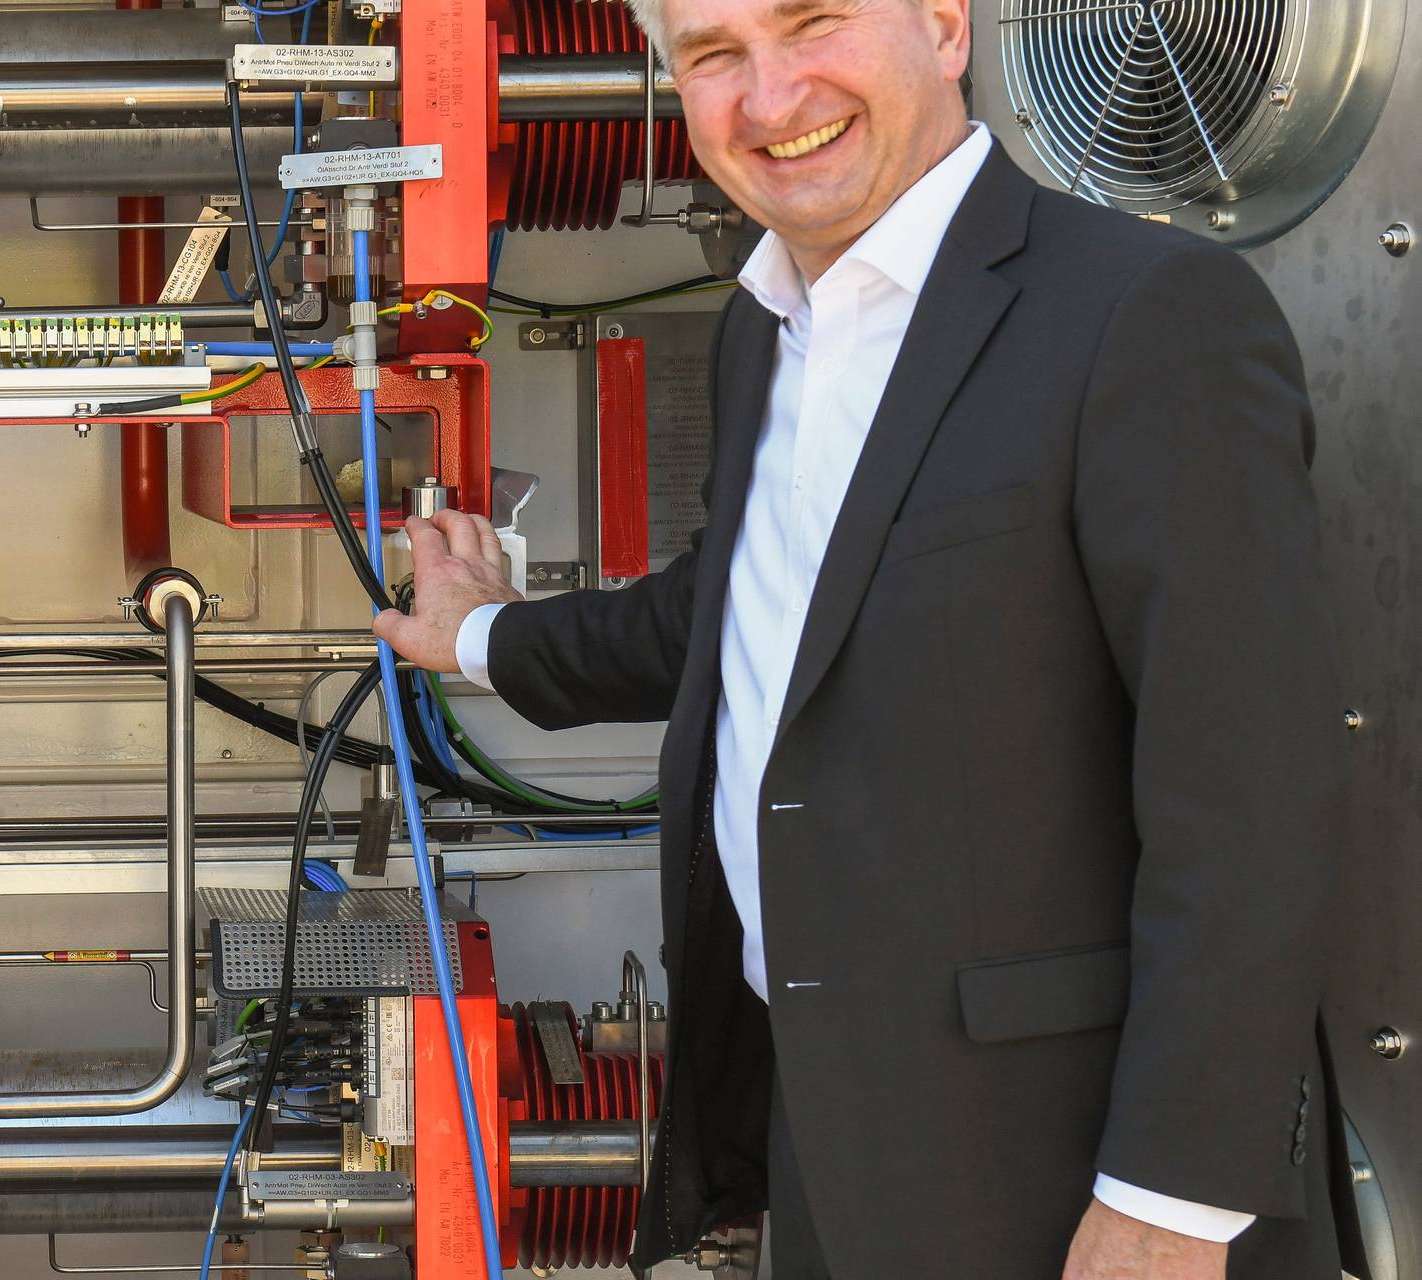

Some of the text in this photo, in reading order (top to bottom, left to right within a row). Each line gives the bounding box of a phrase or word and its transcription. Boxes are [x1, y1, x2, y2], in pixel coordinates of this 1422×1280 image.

[275, 48, 354, 58] 02-RHM-13-AS302
[324, 151, 402, 165] 02-RHM-13-AT701
[390, 161, 403, 169] Stuf
[161, 239, 198, 304] 02-RHM-13-CG104
[288, 1173, 366, 1181] 02-RHM-03-AS302
